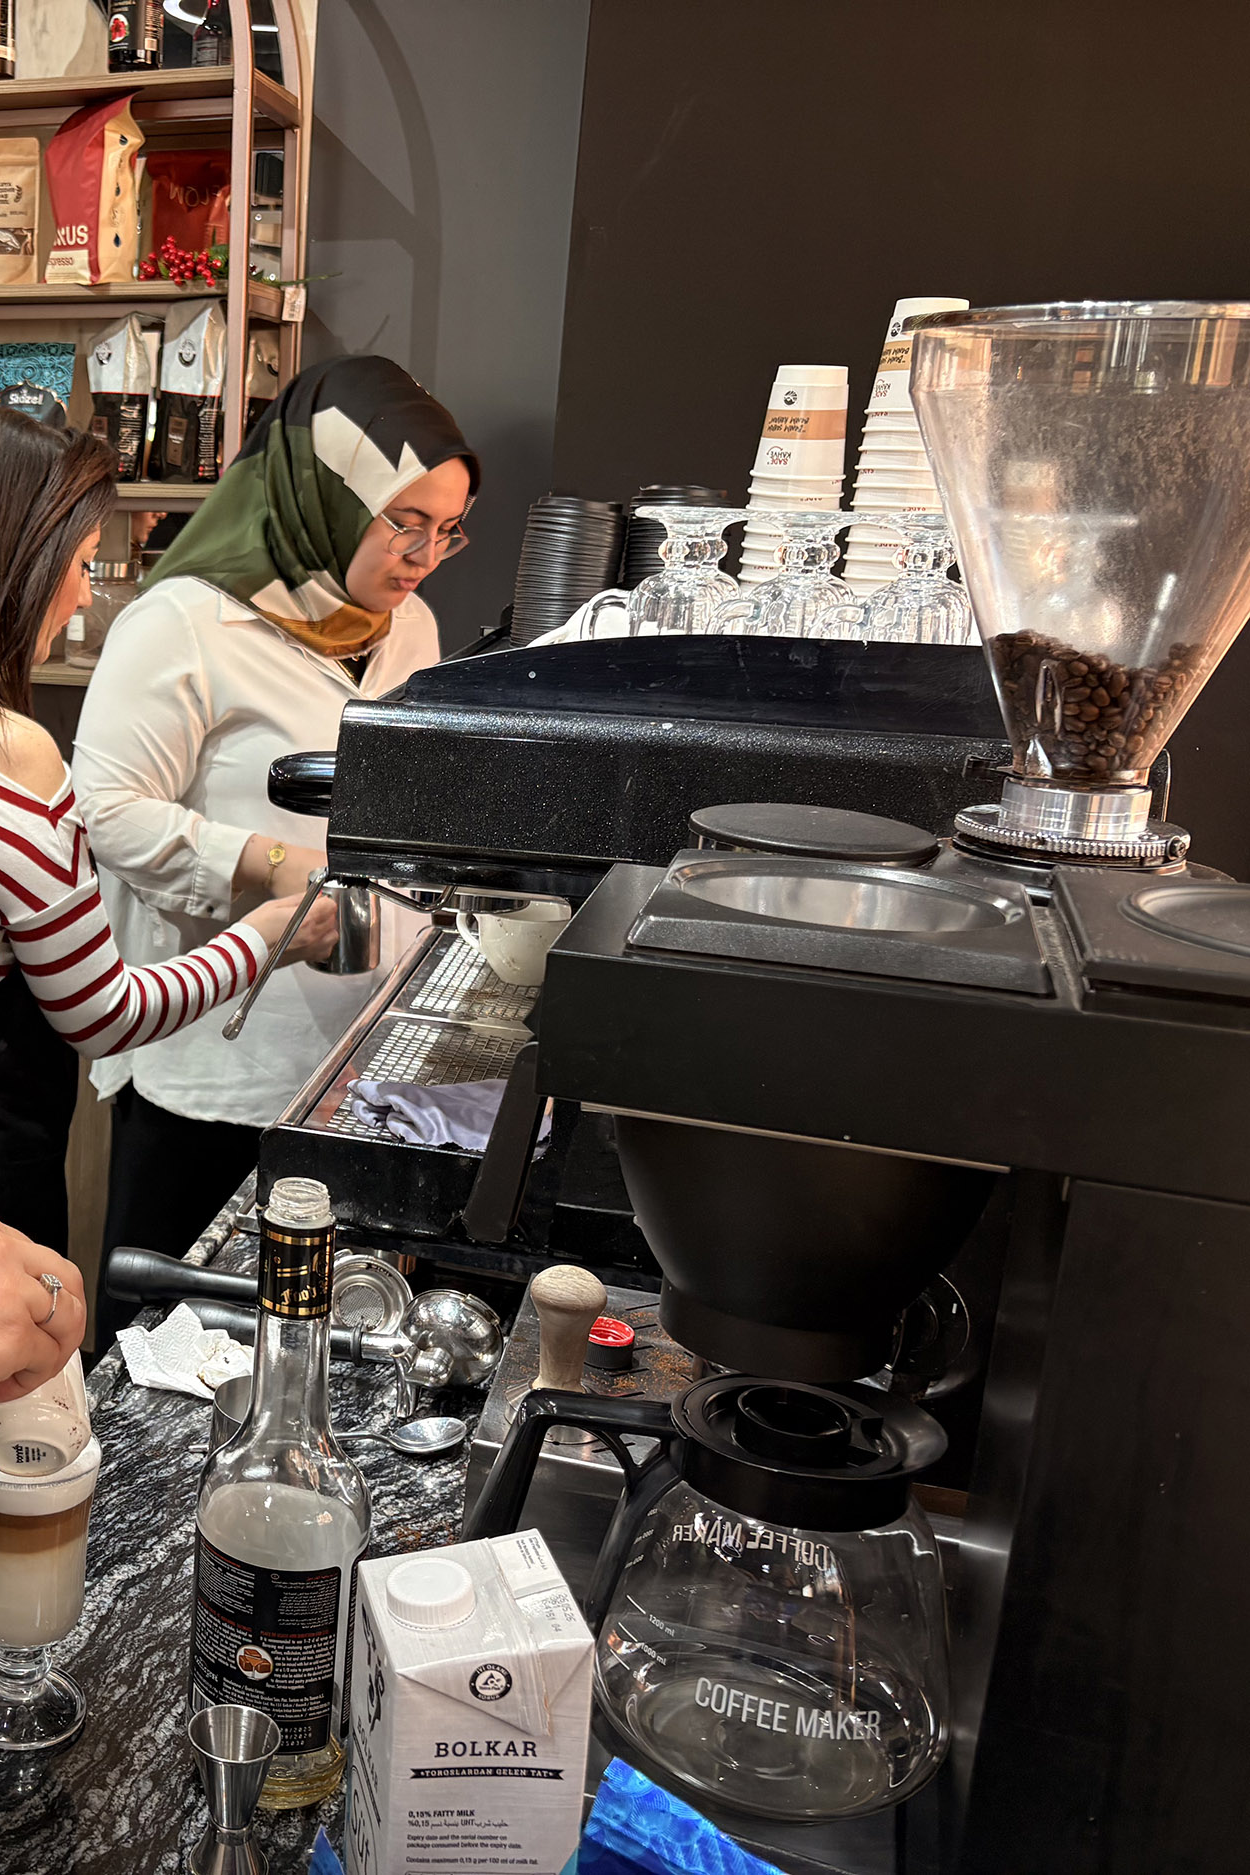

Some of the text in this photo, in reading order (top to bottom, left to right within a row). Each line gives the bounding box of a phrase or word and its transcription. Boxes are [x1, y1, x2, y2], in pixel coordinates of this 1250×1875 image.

[649, 1614, 675, 1637] 1200 ml
[656, 1655, 667, 1666] ml
[695, 1677, 881, 1741] COFFEE MAKER
[434, 1741, 537, 1758] BOLKAR
